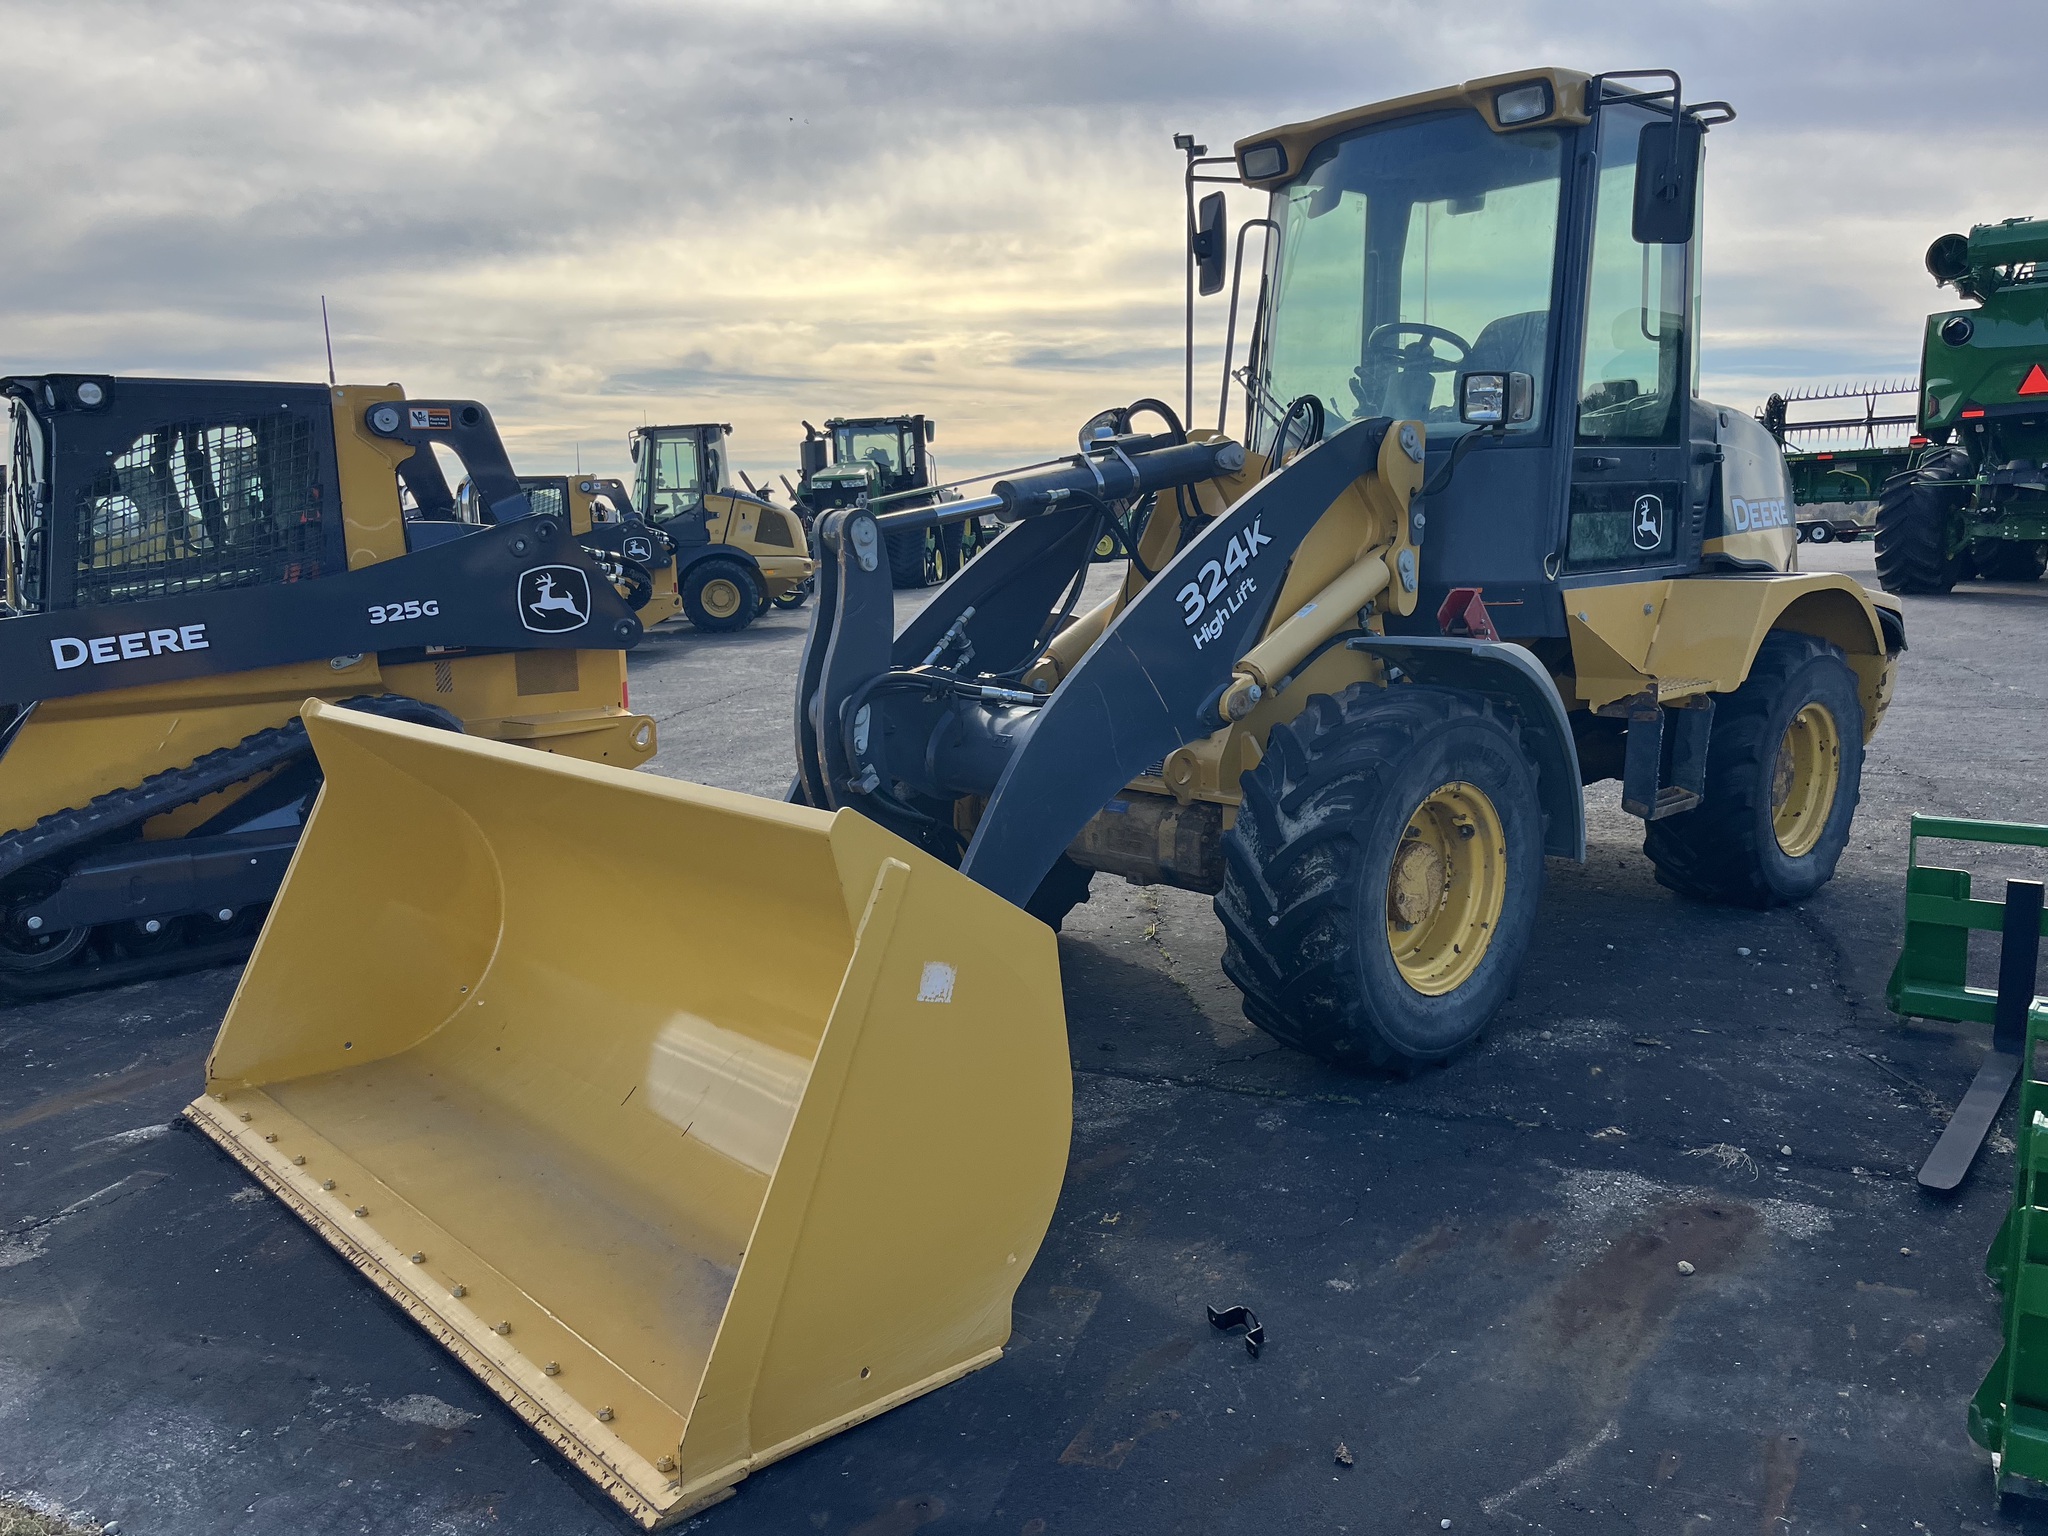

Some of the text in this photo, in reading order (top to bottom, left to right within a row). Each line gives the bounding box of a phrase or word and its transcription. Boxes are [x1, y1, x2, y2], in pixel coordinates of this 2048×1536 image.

[1732, 498, 1789, 531] DEERE
[1175, 513, 1272, 626] 324K
[368, 600, 440, 625] 325G
[1192, 577, 1258, 650] High Lift
[50, 623, 210, 670] DEERE
